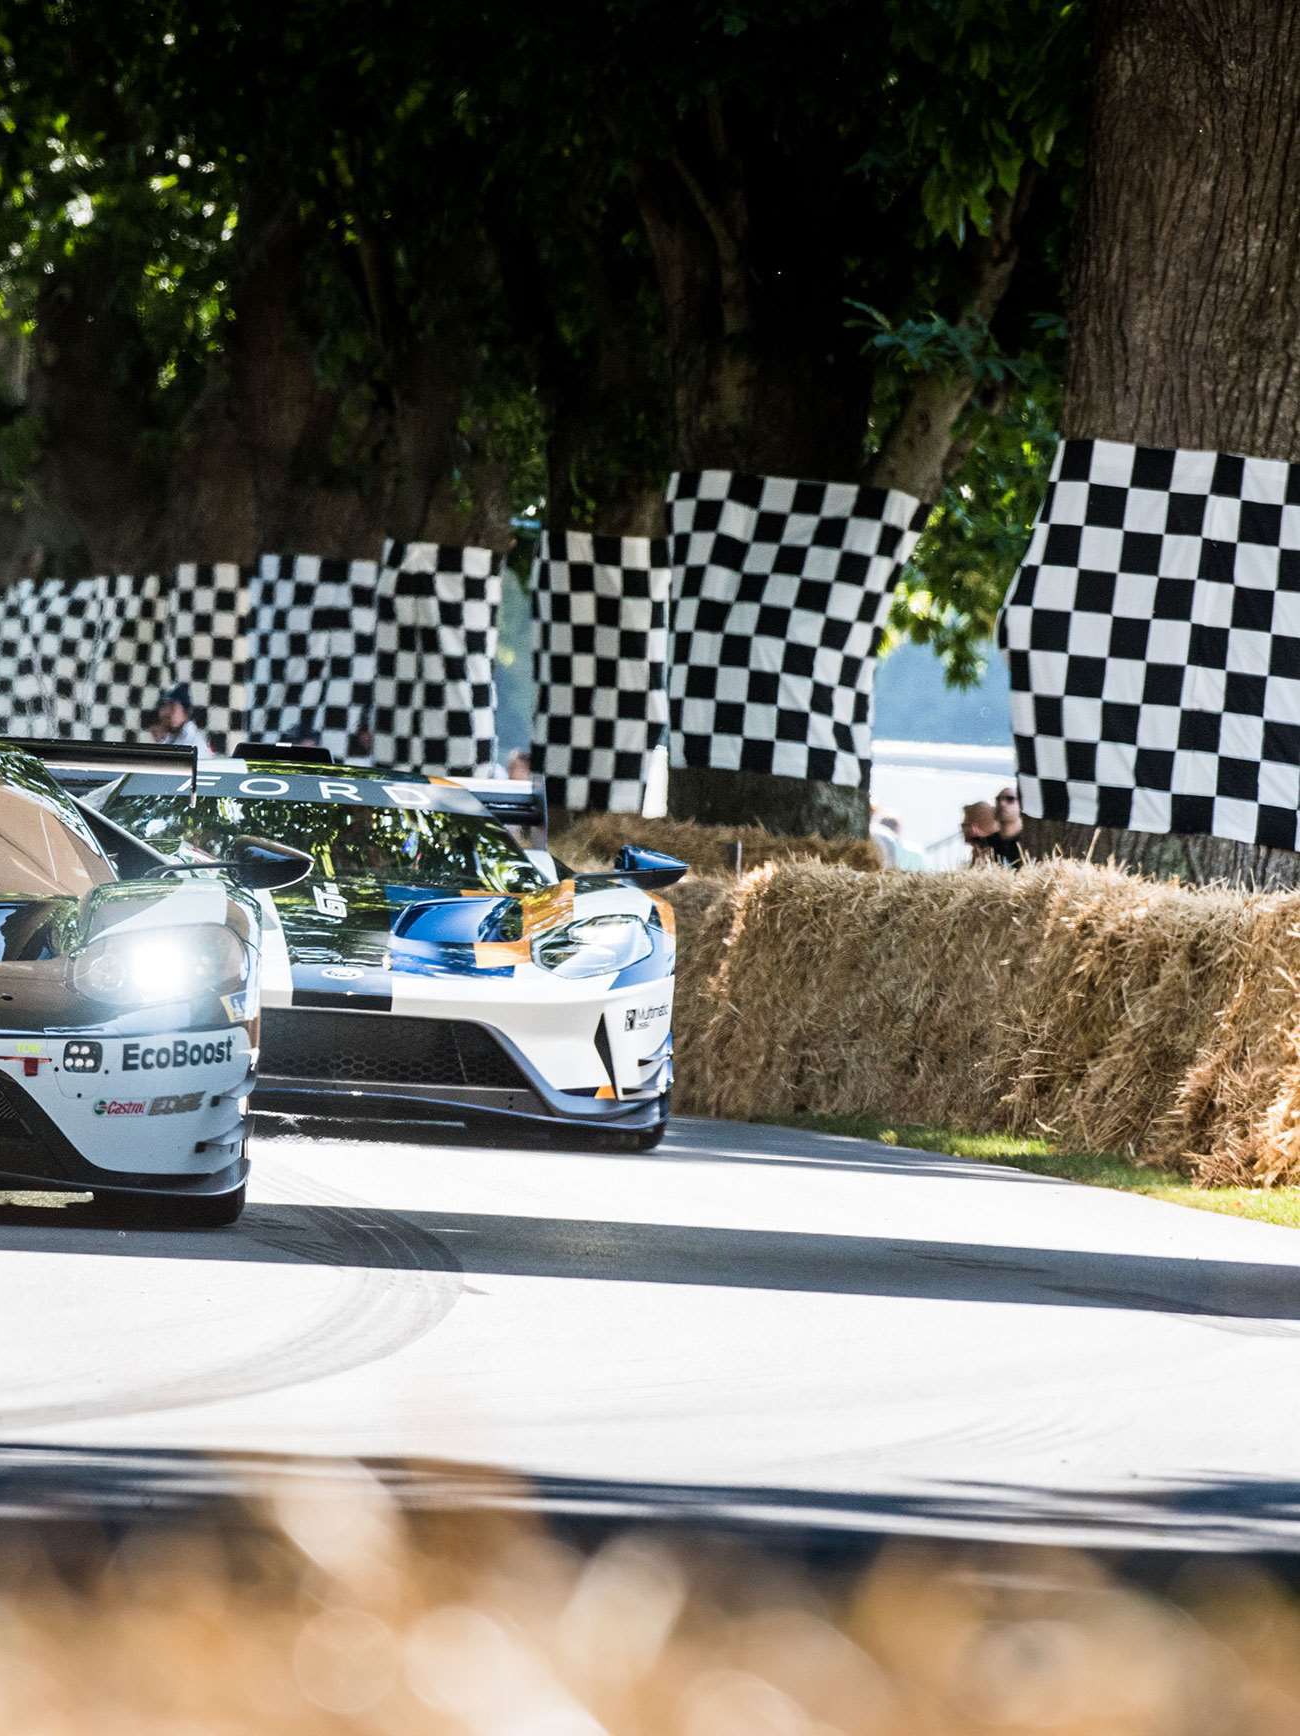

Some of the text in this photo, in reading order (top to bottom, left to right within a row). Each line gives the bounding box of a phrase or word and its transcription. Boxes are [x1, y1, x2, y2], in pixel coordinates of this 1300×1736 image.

[176, 775, 433, 805] FORD
[122, 1036, 233, 1071] EcoBoost
[107, 1091, 206, 1115] Castrol EDGE
